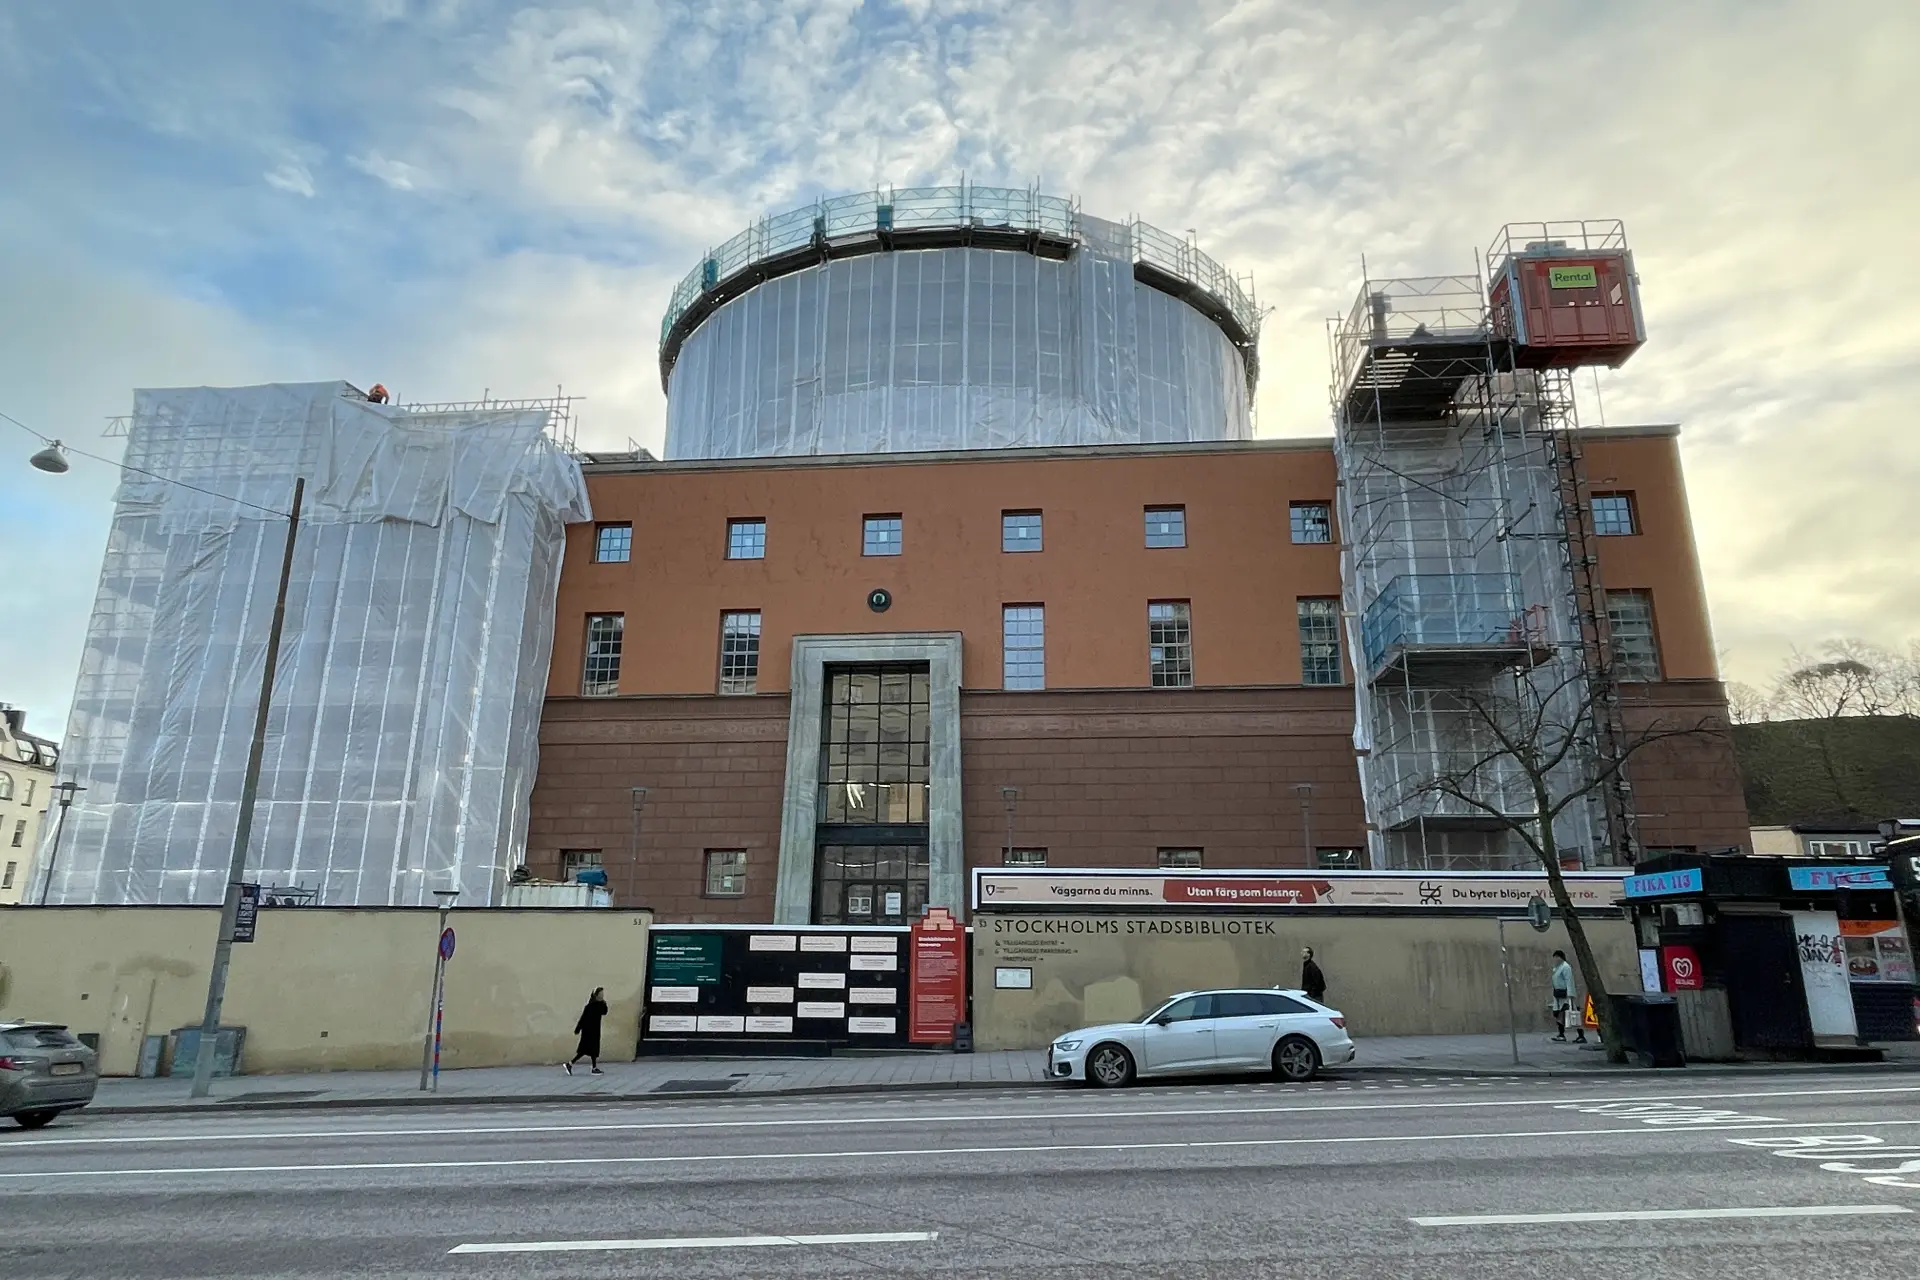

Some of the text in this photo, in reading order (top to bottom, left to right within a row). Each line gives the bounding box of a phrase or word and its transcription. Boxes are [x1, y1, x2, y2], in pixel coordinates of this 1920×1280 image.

[1555, 272, 1592, 282] Rental
[1634, 877, 1667, 892] FIKA
[1050, 886, 1154, 897] Väggarna du minns.
[1187, 886, 1303, 899] Utan färg som lossnar.
[1452, 888, 1467, 898] Du
[1469, 888, 1498, 900] byter
[1535, 889, 1547, 898] Vi
[1578, 889, 1599, 899] rör.
[994, 919, 1276, 935] STOCKHOLMS STADSBIBLIOTEK
